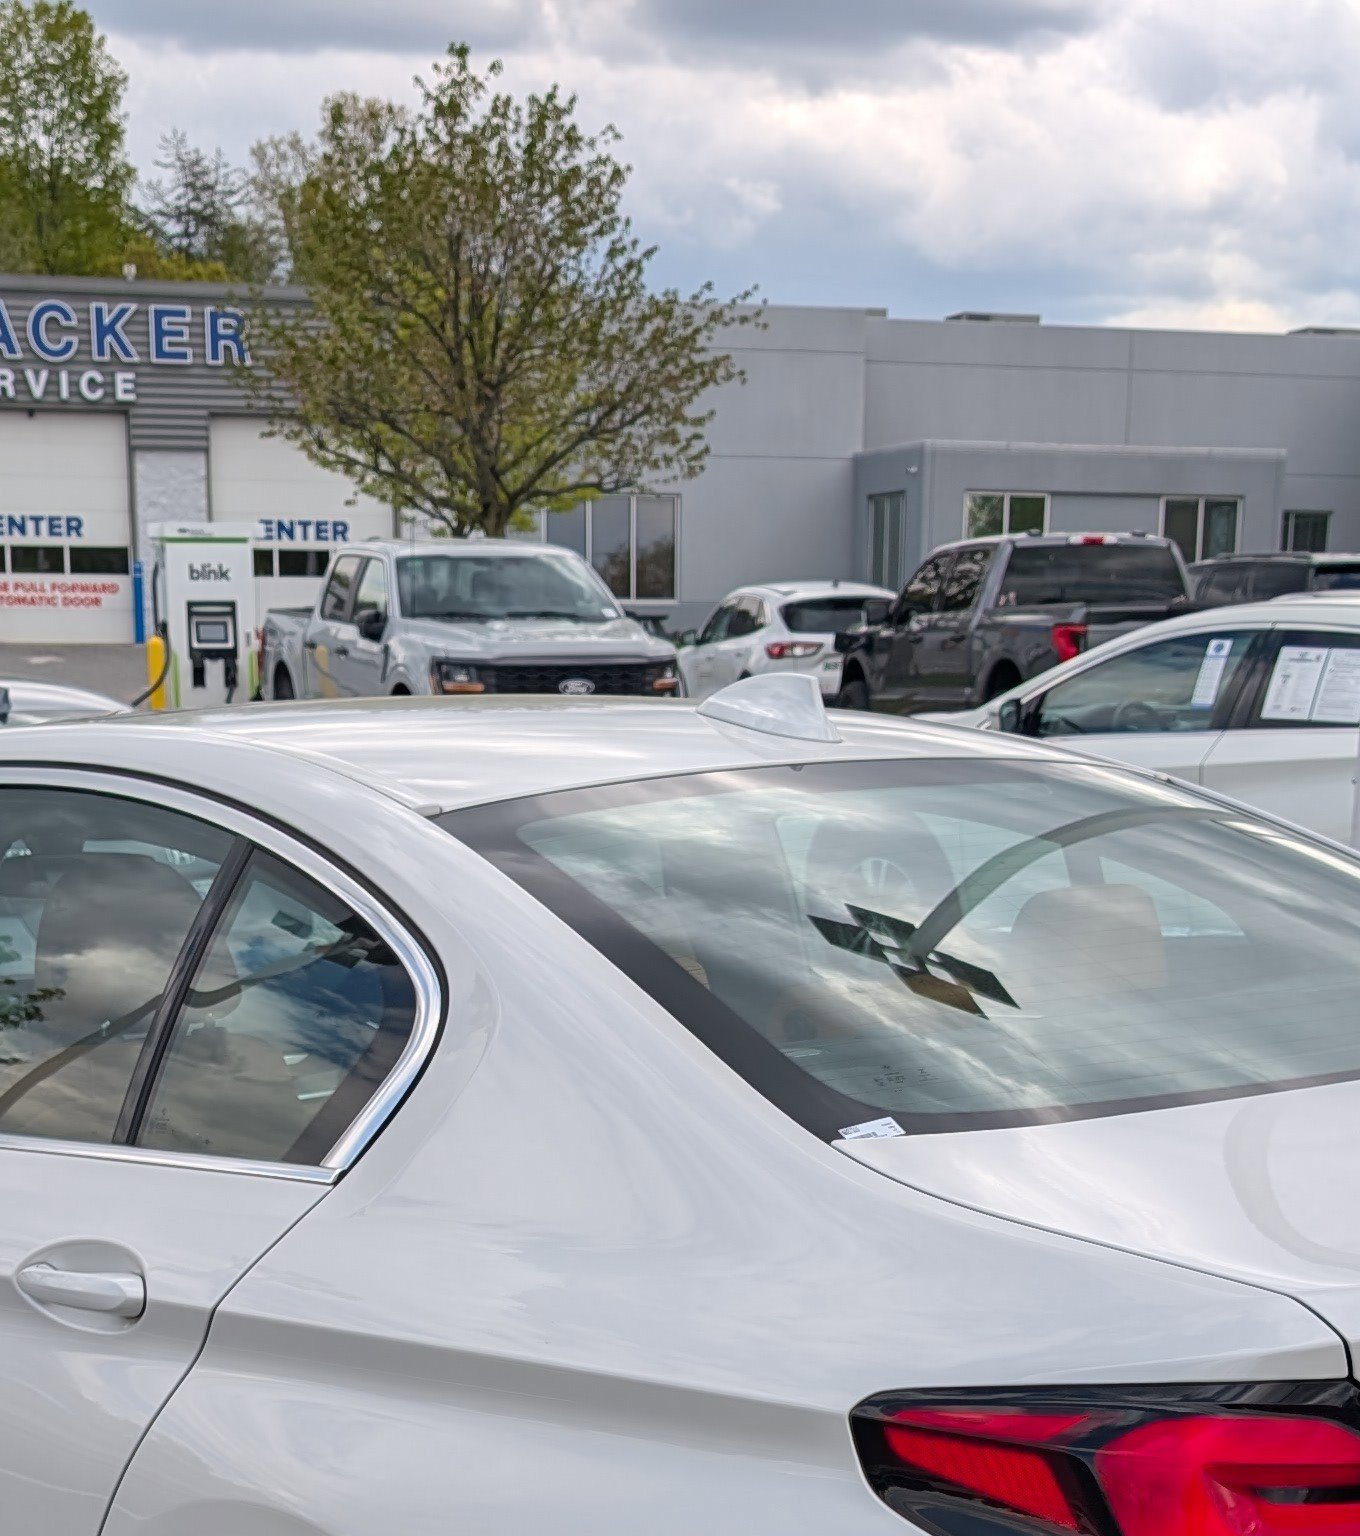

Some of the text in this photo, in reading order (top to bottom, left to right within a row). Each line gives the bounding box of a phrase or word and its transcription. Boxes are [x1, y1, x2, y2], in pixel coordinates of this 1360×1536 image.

[188, 563, 232, 581] blink
[14, 581, 47, 593] PULL
[61, 596, 103, 608] DOOR
